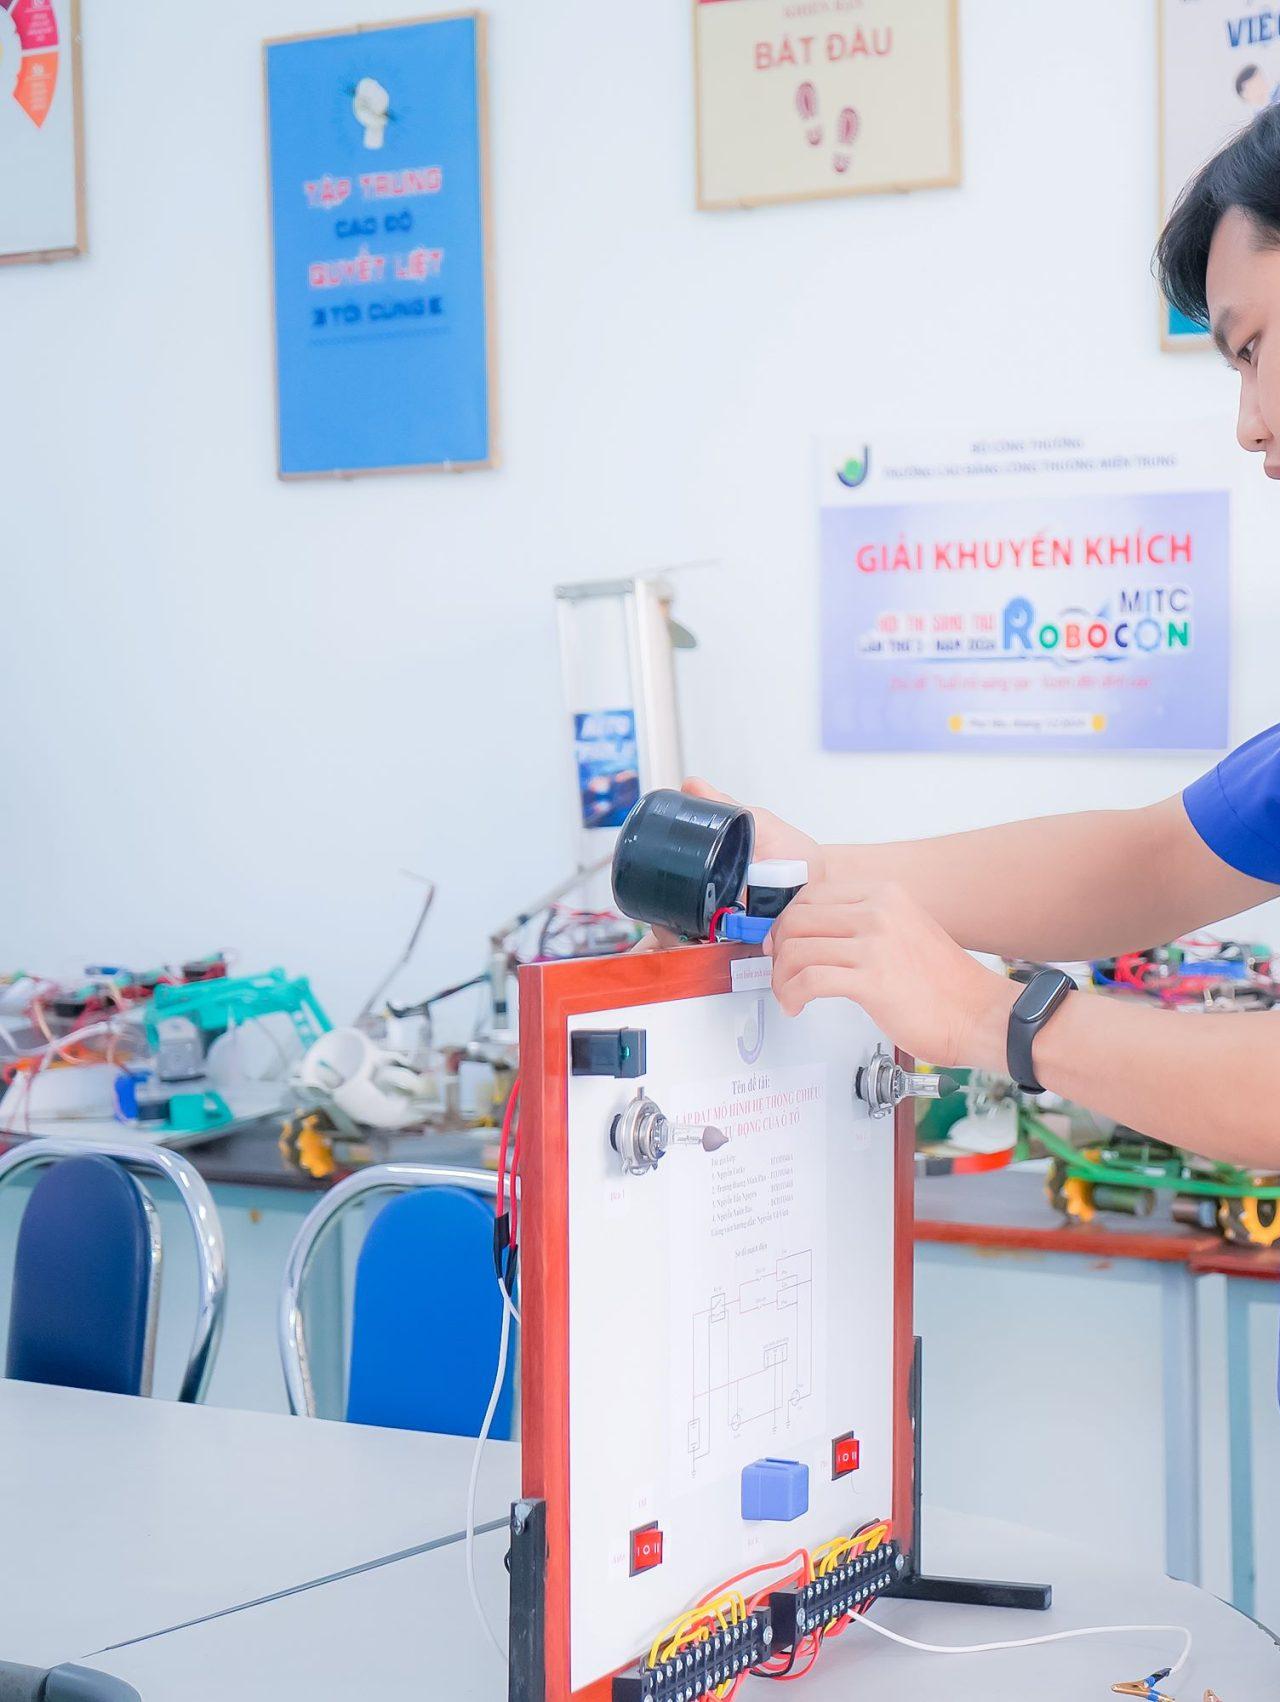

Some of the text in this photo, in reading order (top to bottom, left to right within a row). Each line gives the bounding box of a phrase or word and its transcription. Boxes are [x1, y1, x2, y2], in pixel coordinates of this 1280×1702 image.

[360, 165, 442, 199] TRUNG
[856, 526, 1192, 573] GIẢI KHUYẾN KHÍCH
[1120, 588, 1188, 613] MITC
[1002, 595, 1188, 650] ROBOCON
